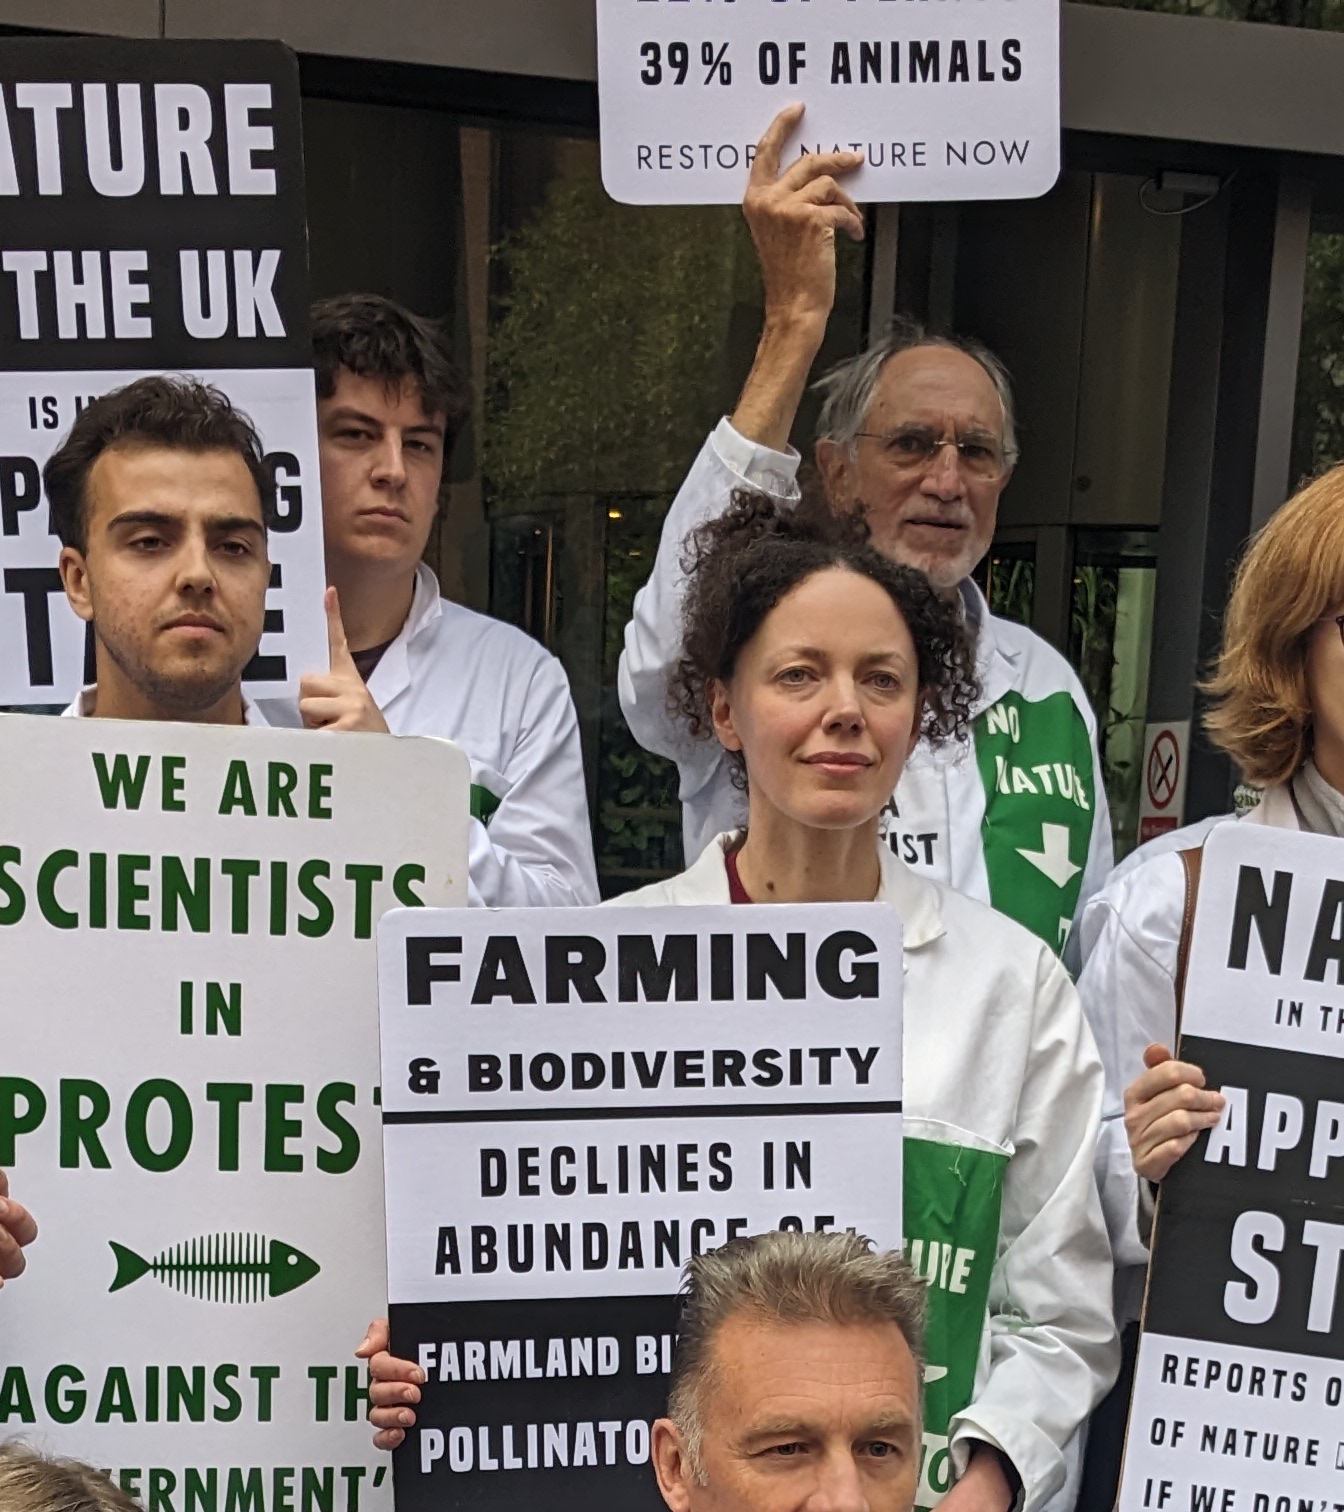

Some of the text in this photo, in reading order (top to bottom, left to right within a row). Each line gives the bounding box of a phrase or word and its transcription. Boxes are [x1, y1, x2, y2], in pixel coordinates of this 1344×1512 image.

[758, 41, 806, 85] OF
[831, 39, 1023, 85] ANIMALS
[3, 251, 152, 339] THE
[179, 249, 286, 338] UK
[987, 703, 1021, 744] NO
[92, 752, 334, 819] WE ARE
[405, 930, 880, 1006] FARMING
[180, 981, 242, 1036] IN
[1275, 999, 1302, 1028] IN
[408, 1047, 881, 1095] & BIODIVERSITY
[480, 1141, 812, 1197] DECLINES IN
